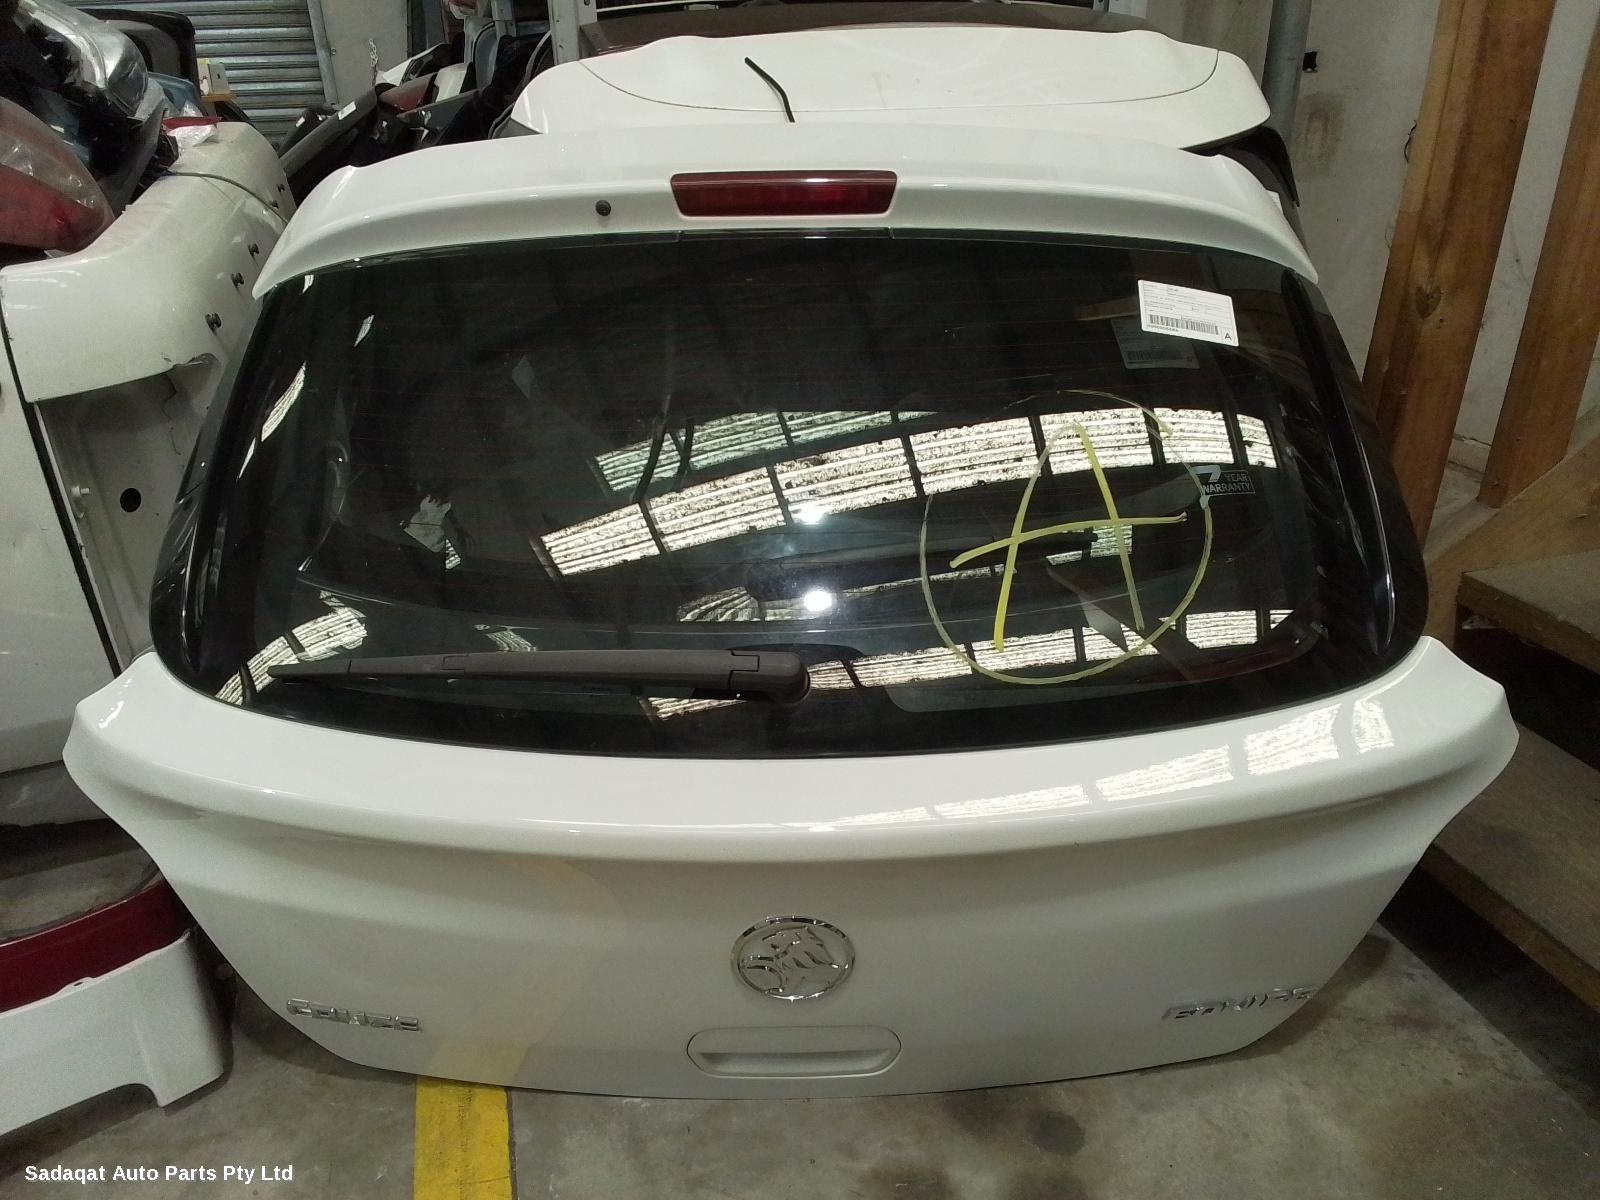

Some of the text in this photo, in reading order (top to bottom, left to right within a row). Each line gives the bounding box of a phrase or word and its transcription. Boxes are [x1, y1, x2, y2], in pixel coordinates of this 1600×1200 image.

[1224, 332, 1232, 341] A
[1225, 472, 1249, 482] YEAR
[1202, 482, 1250, 494] WARRANTY
